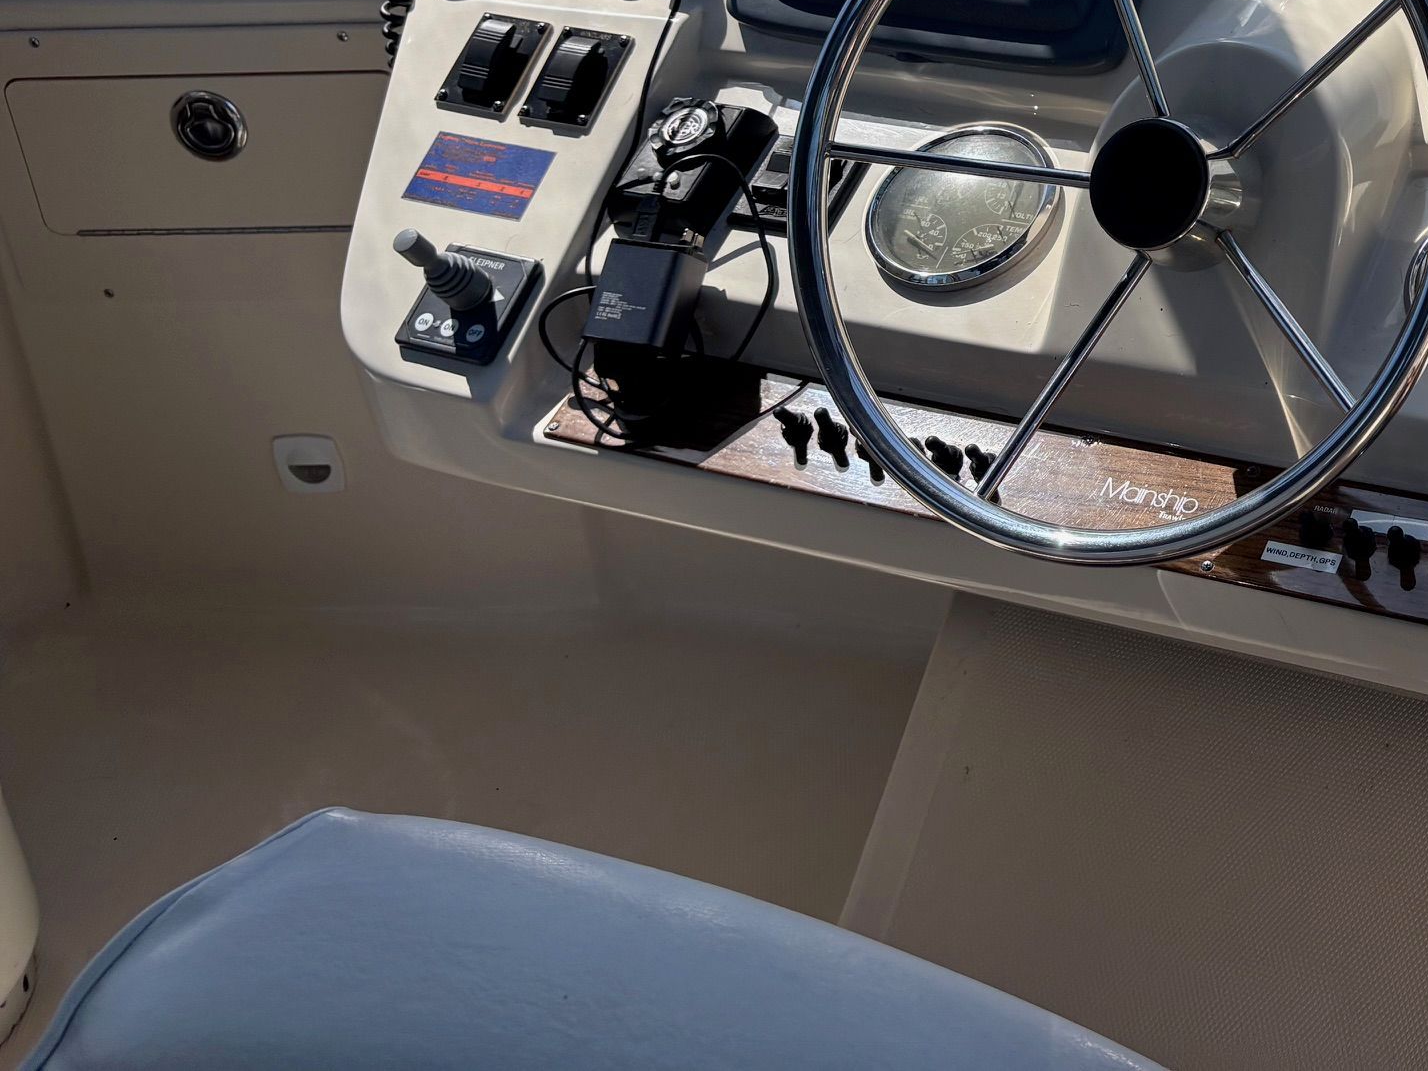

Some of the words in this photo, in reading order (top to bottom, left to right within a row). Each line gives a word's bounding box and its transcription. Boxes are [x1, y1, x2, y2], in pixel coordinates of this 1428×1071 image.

[418, 317, 430, 326] ON
[444, 322, 456, 331] ON
[1100, 477, 1199, 516] Mainship
[1314, 505, 1338, 514] RADAR
